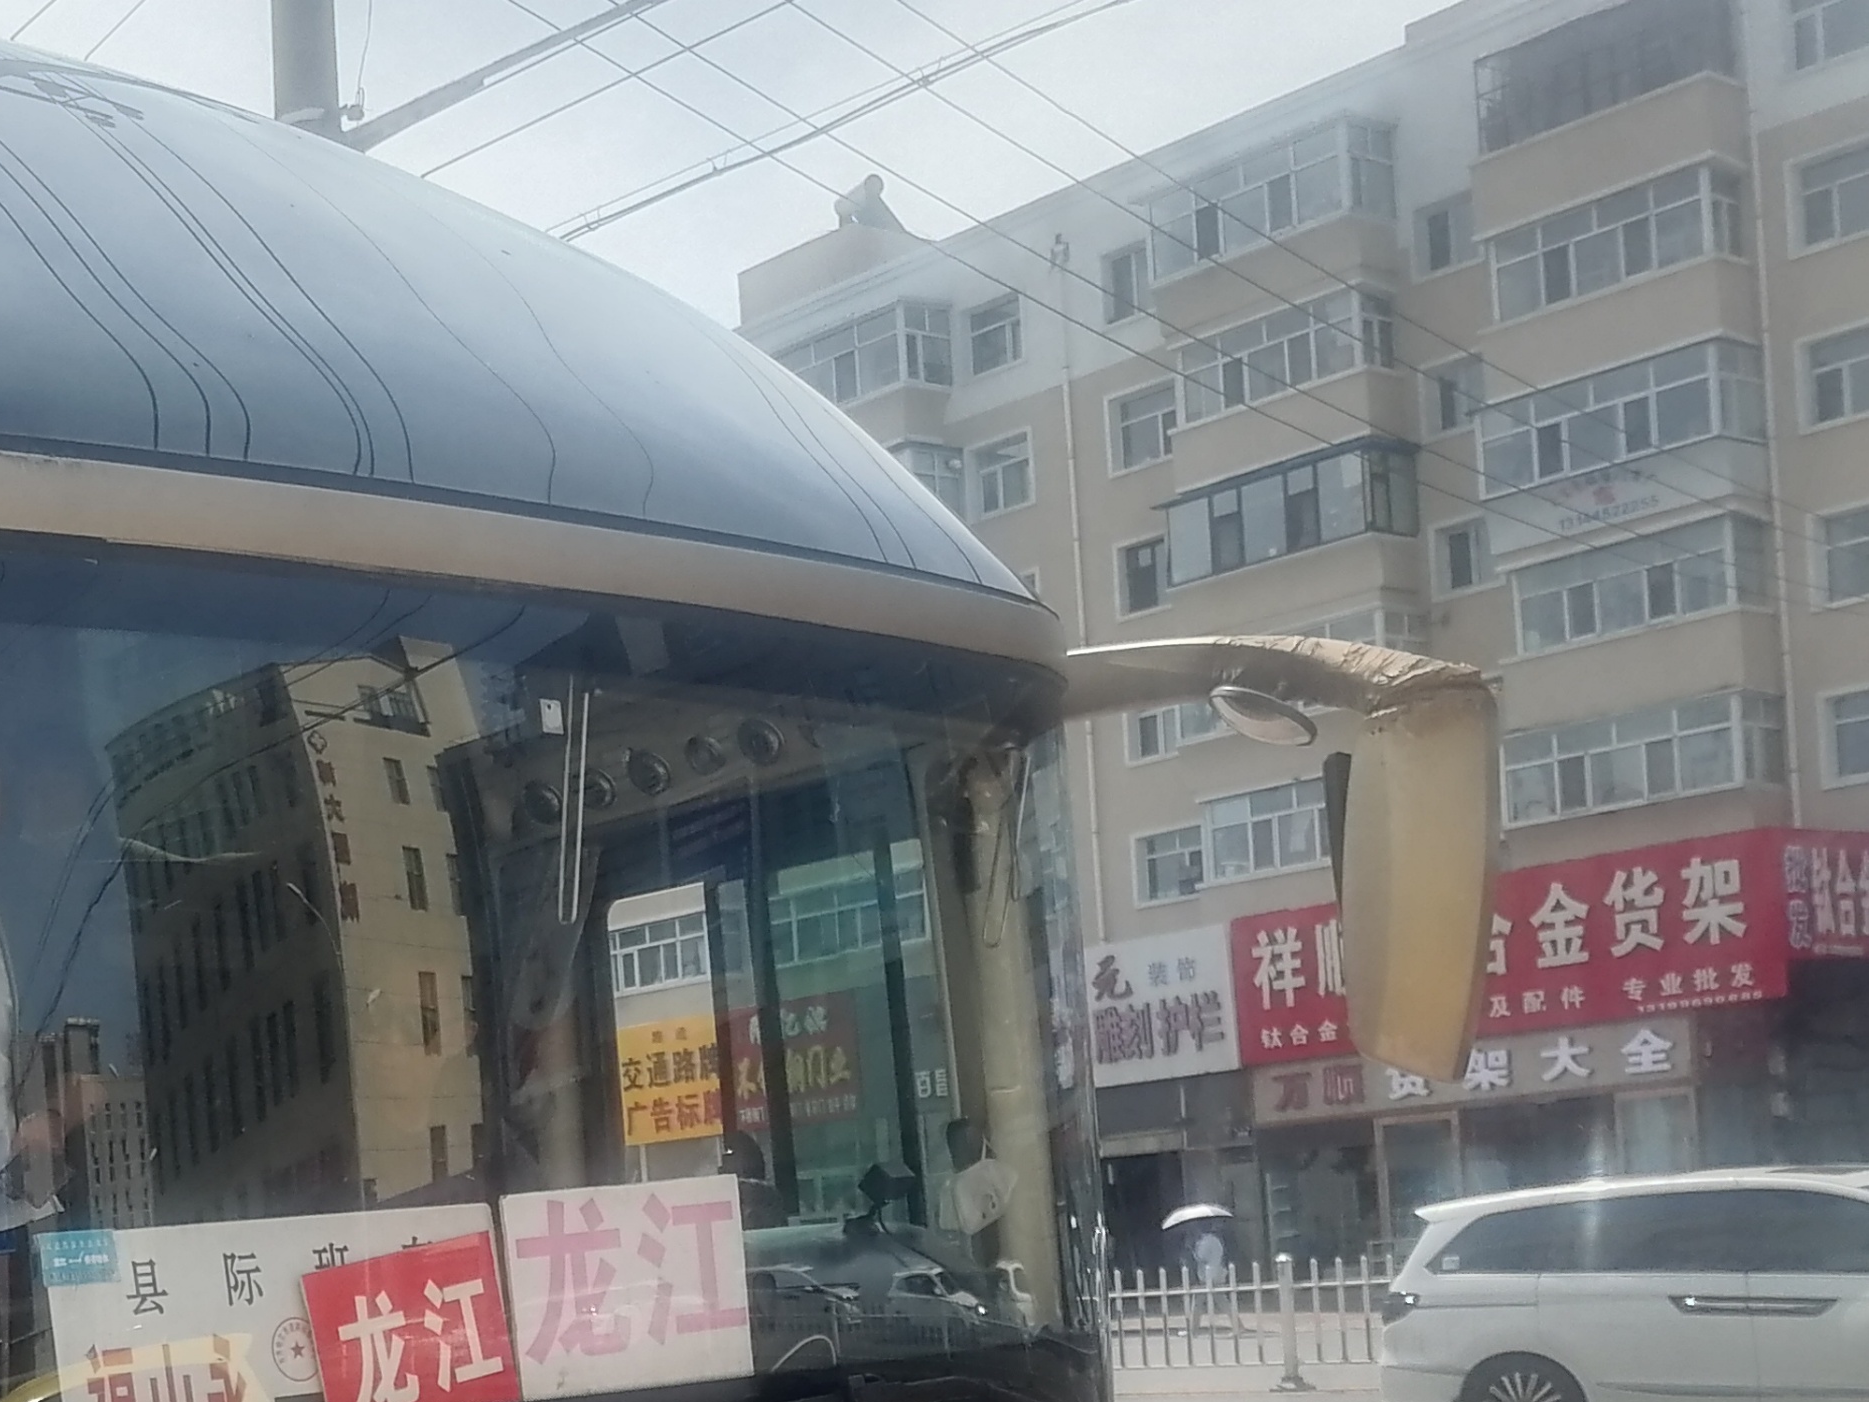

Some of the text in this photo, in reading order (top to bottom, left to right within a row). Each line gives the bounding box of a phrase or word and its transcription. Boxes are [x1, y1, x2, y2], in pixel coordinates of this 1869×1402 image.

[1622, 963, 1756, 1001] 专业批发
[514, 1192, 746, 1367] 龙江
